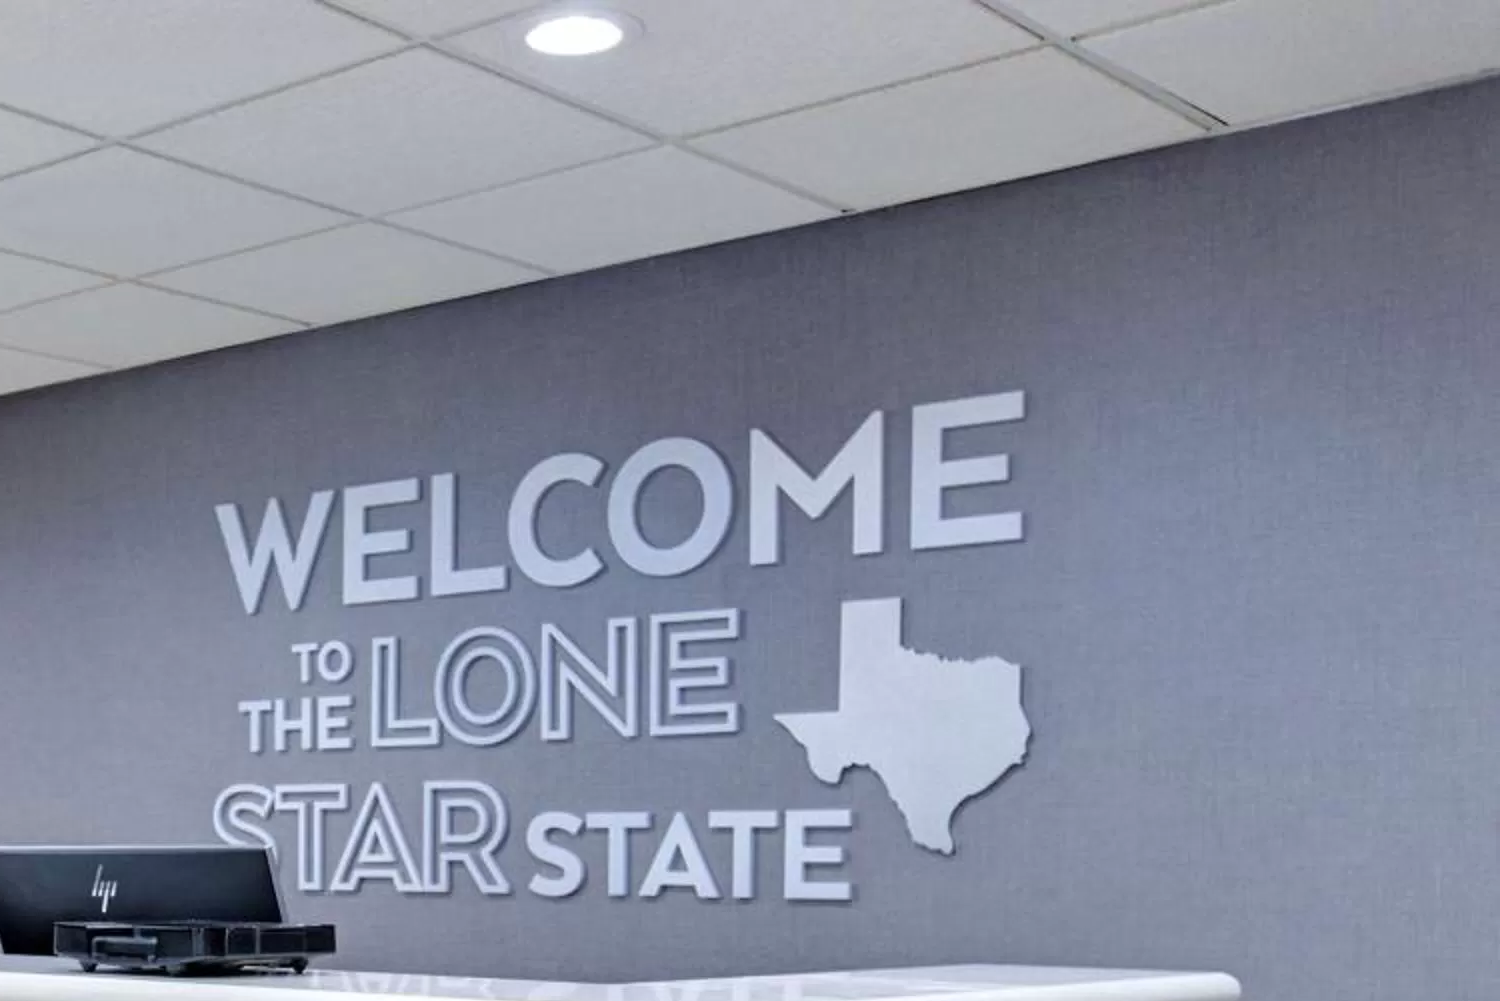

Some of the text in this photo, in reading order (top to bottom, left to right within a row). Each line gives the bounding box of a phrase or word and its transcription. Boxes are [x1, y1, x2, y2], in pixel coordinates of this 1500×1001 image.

[214, 390, 1024, 614] WELCOME
[238, 608, 739, 752] THE LONE
[291, 640, 353, 683] TO
[213, 782, 851, 900] STAR STATE
